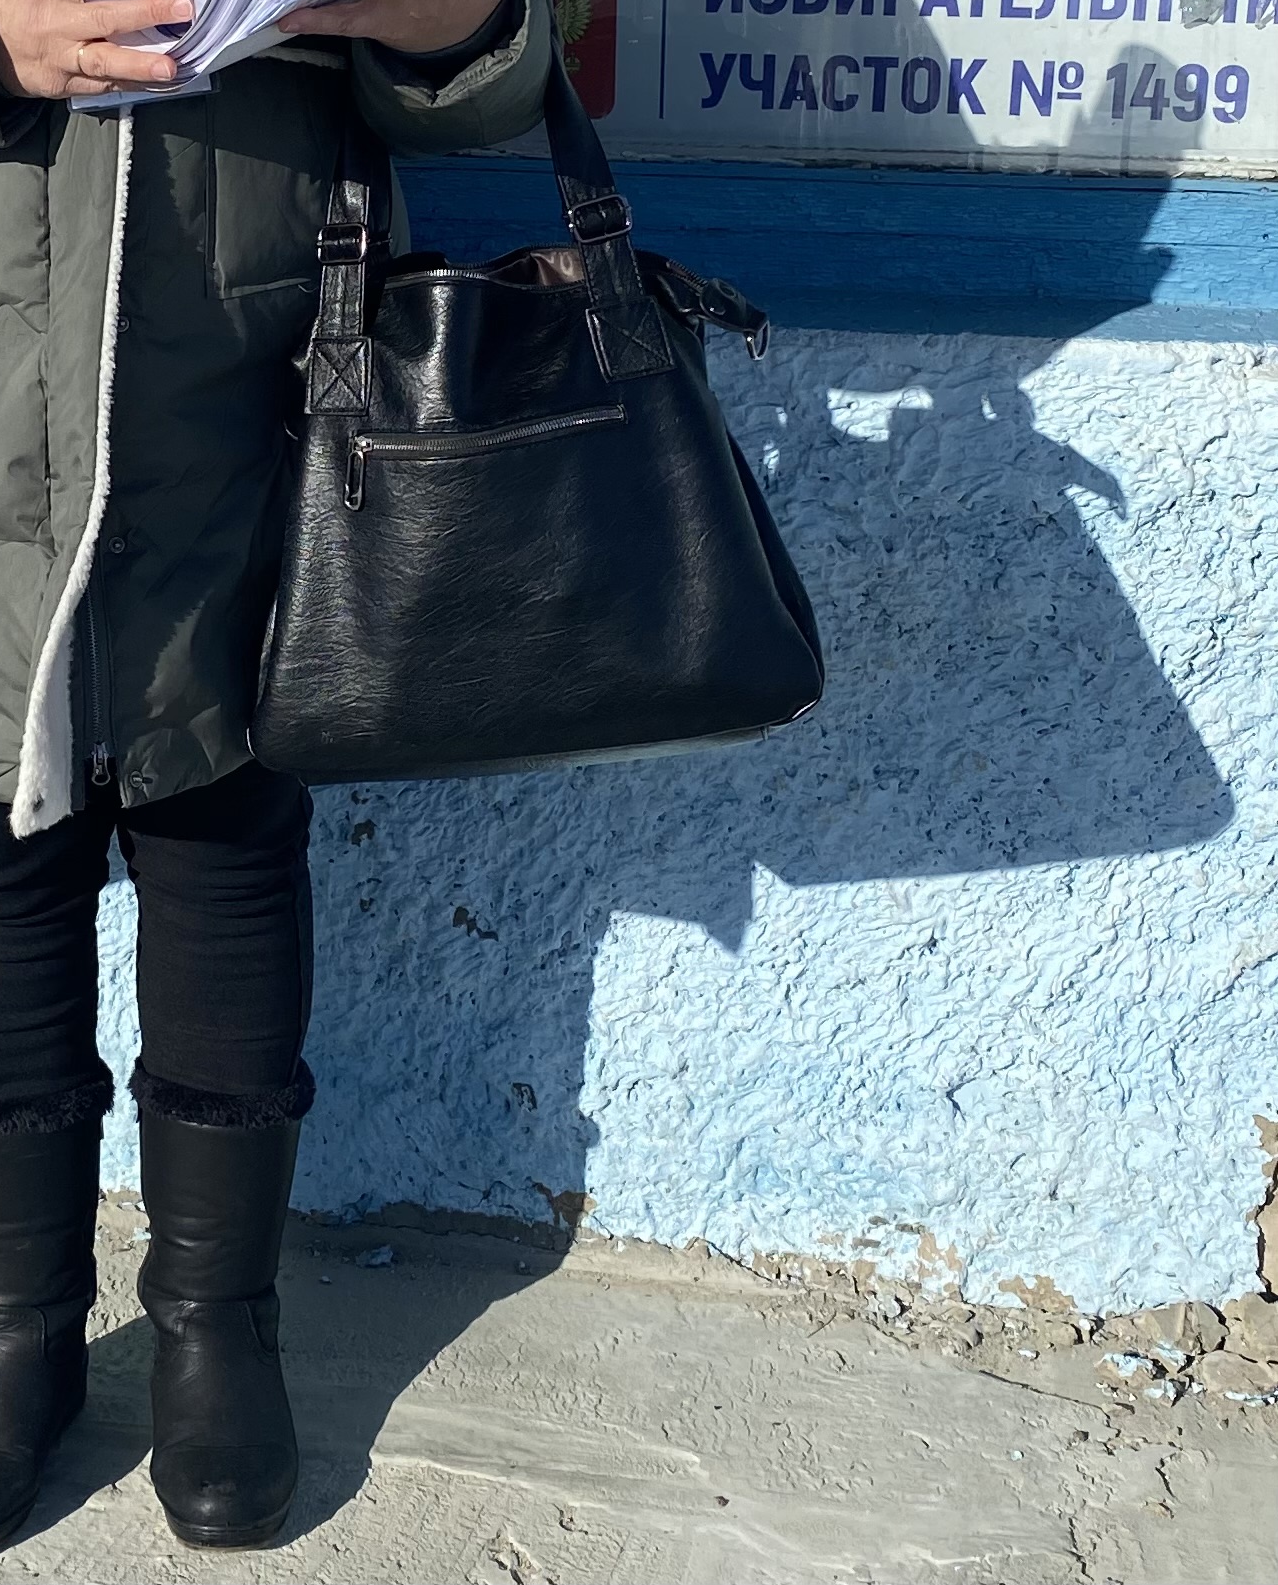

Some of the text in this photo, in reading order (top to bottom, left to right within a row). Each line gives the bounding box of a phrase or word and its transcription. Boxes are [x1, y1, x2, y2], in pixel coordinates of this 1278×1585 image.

[699, 52, 1250, 124] УЧАСТОК № 1499
